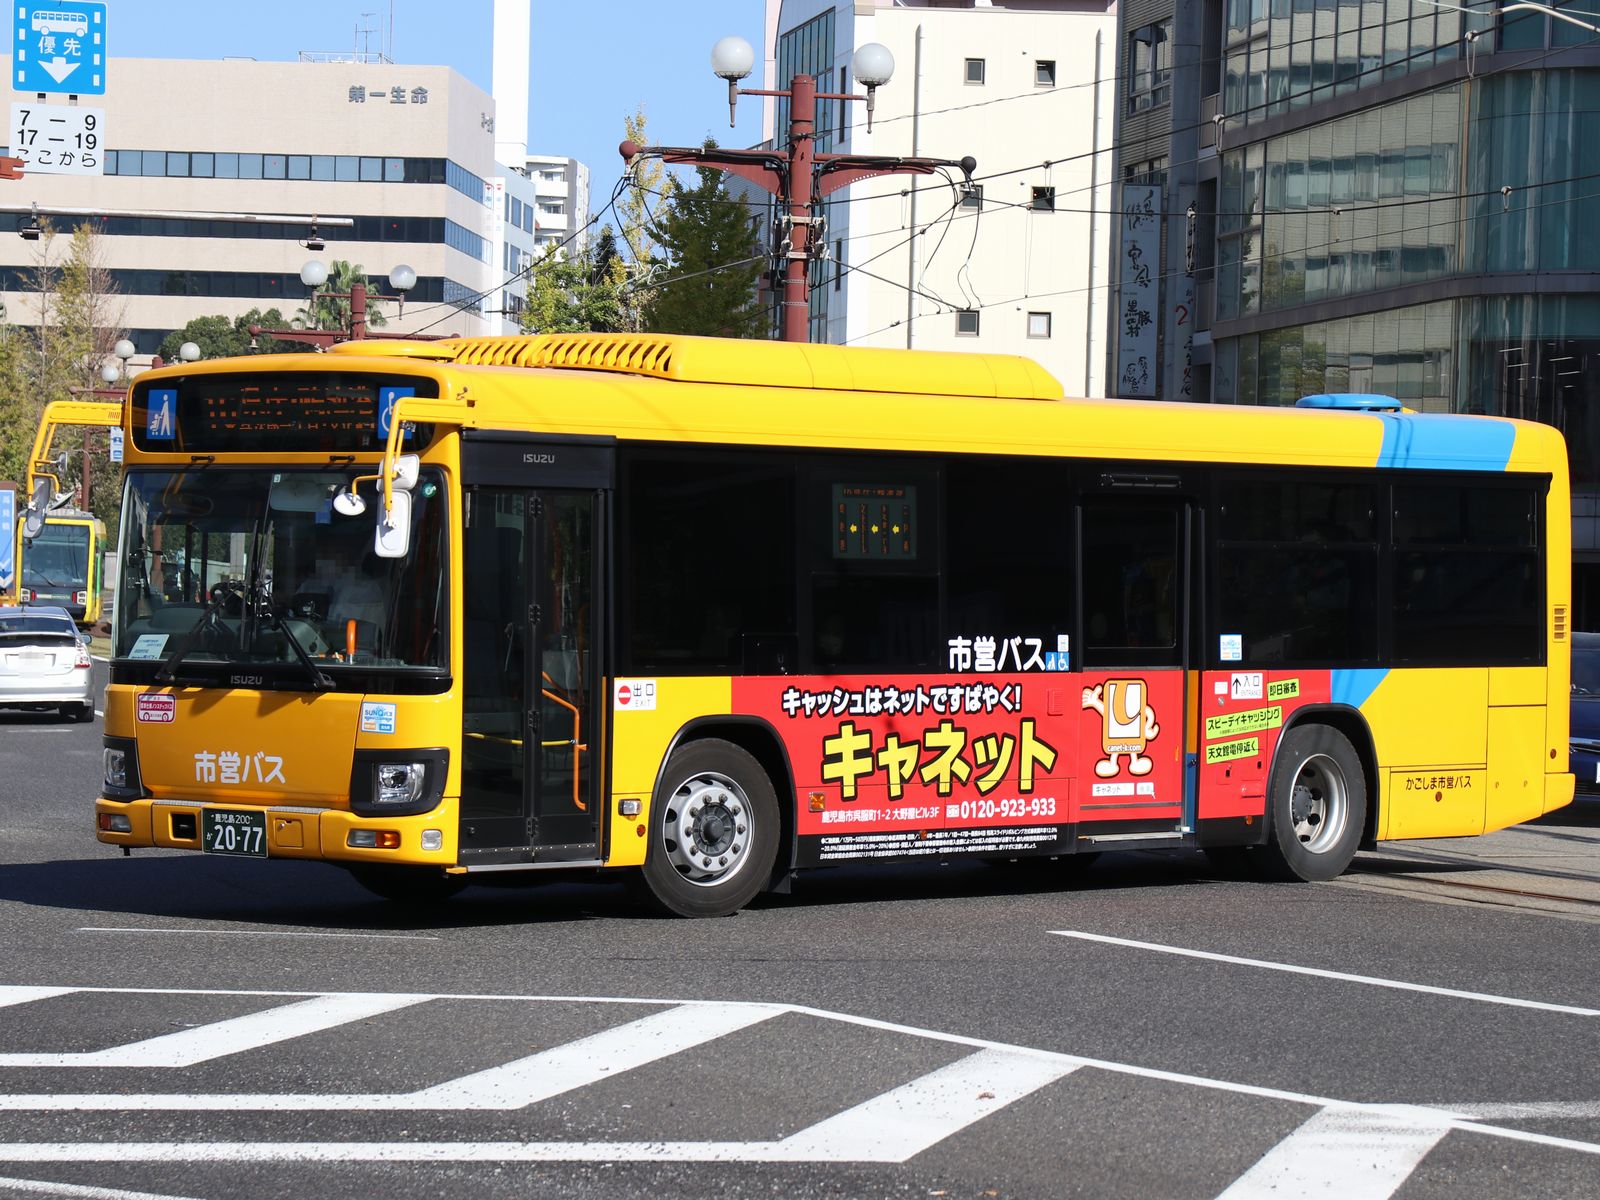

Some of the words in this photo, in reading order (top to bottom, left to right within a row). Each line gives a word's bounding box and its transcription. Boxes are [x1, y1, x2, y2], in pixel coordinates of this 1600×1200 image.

[38, 36, 82, 56] 優先
[348, 85, 429, 104] 第一生命
[20, 110, 31, 126] 7
[84, 114, 96, 131] 9
[17, 128, 38, 145] 17
[74, 133, 97, 150] 19
[16, 148, 97, 168] ここから
[522, 453, 556, 464] ISUZU
[947, 635, 1046, 672] 市営バス
[229, 675, 264, 686] ISUZU
[1243, 675, 1260, 687] 入口
[1268, 682, 1298, 697] 即日審査
[633, 684, 655, 698] 出口
[820, 717, 1058, 803] キャネット
[1207, 740, 1256, 760] 天文館電停近く
[193, 750, 286, 785] 市営バス
[1405, 775, 1472, 791] かごしま市営バス
[960, 797, 1056, 820] 0120-923-933
